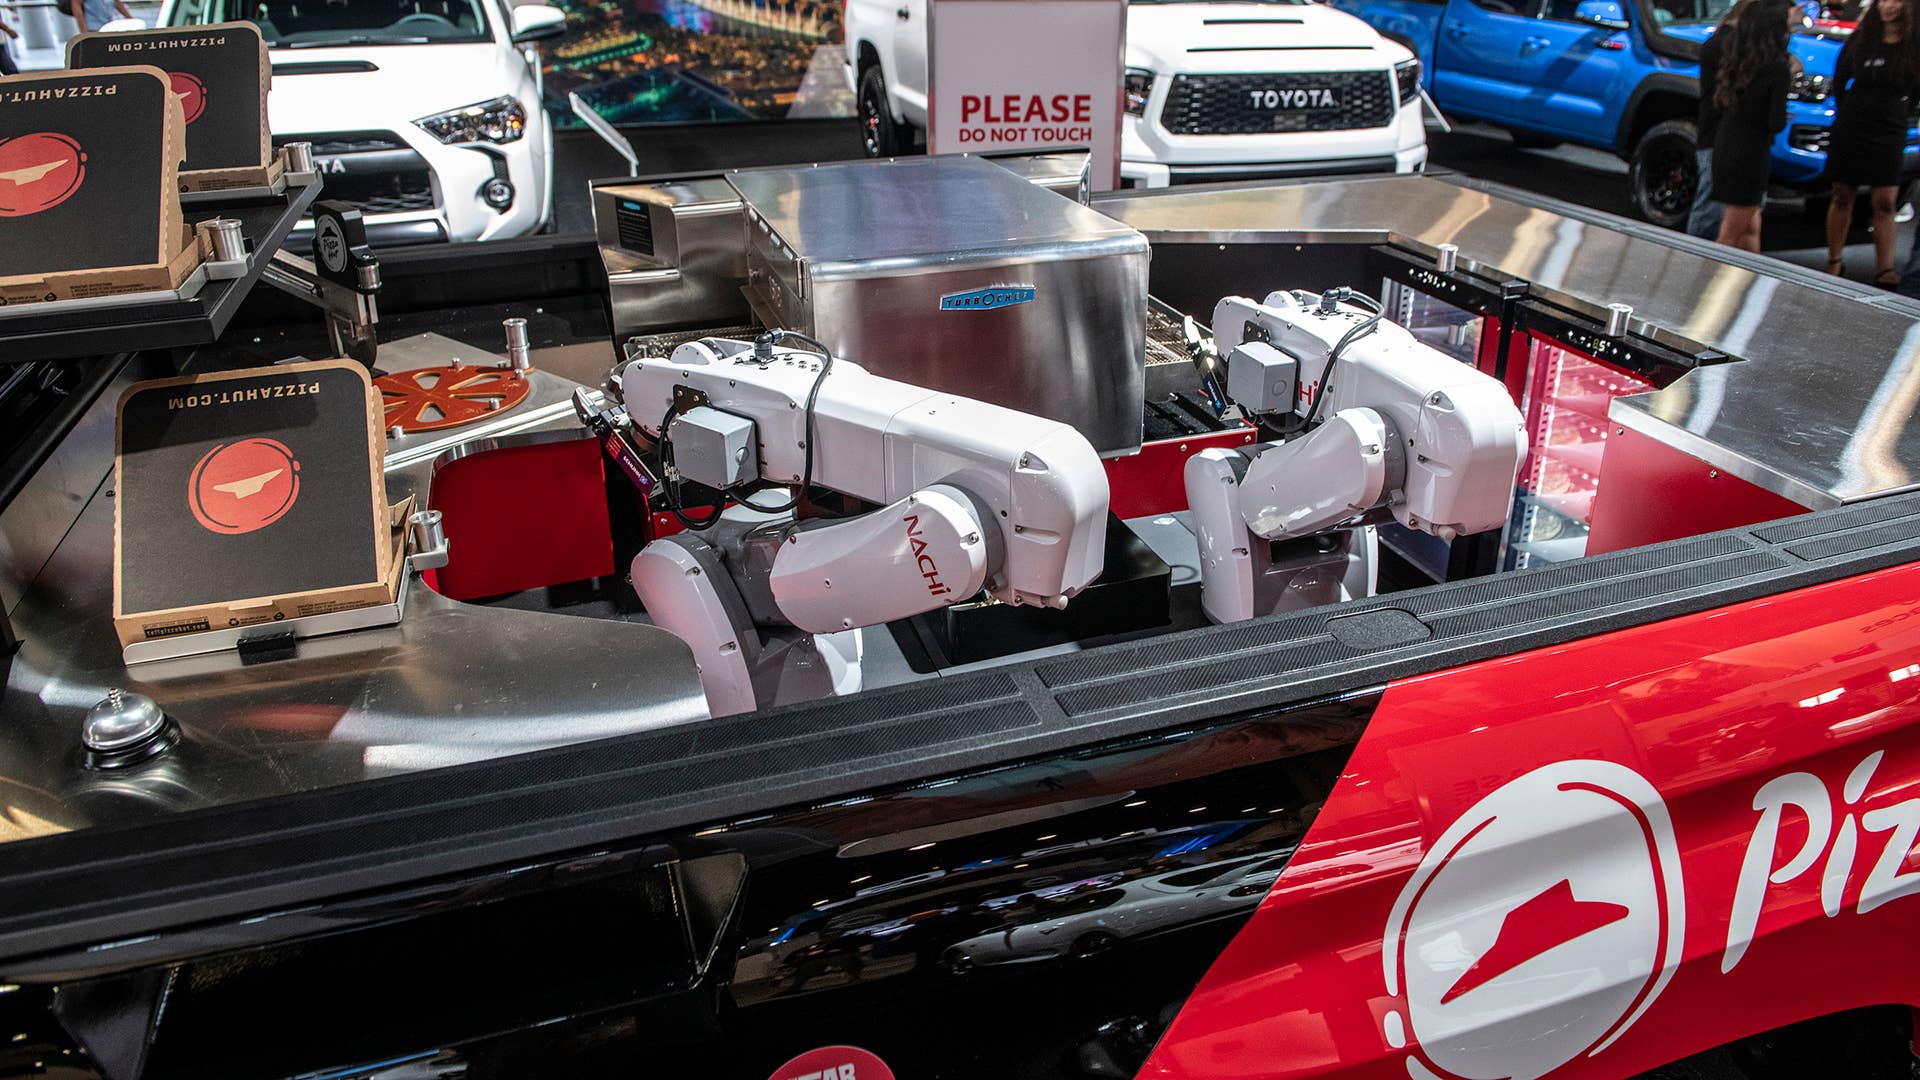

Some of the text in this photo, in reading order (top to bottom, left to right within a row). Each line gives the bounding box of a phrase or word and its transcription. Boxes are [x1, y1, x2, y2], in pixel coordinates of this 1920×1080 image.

[108, 37, 226, 53] PIZZAHUT.COM
[0, 84, 118, 103] PIZZAHUT.
[1250, 89, 1335, 109] TOYOTA
[961, 94, 1092, 124] PLEASE
[959, 127, 1093, 142] DO NOT TOUCH
[315, 158, 346, 174] TA
[946, 291, 1029, 307] TURBOCHEF
[168, 382, 320, 410] PIZZAHUT.COM
